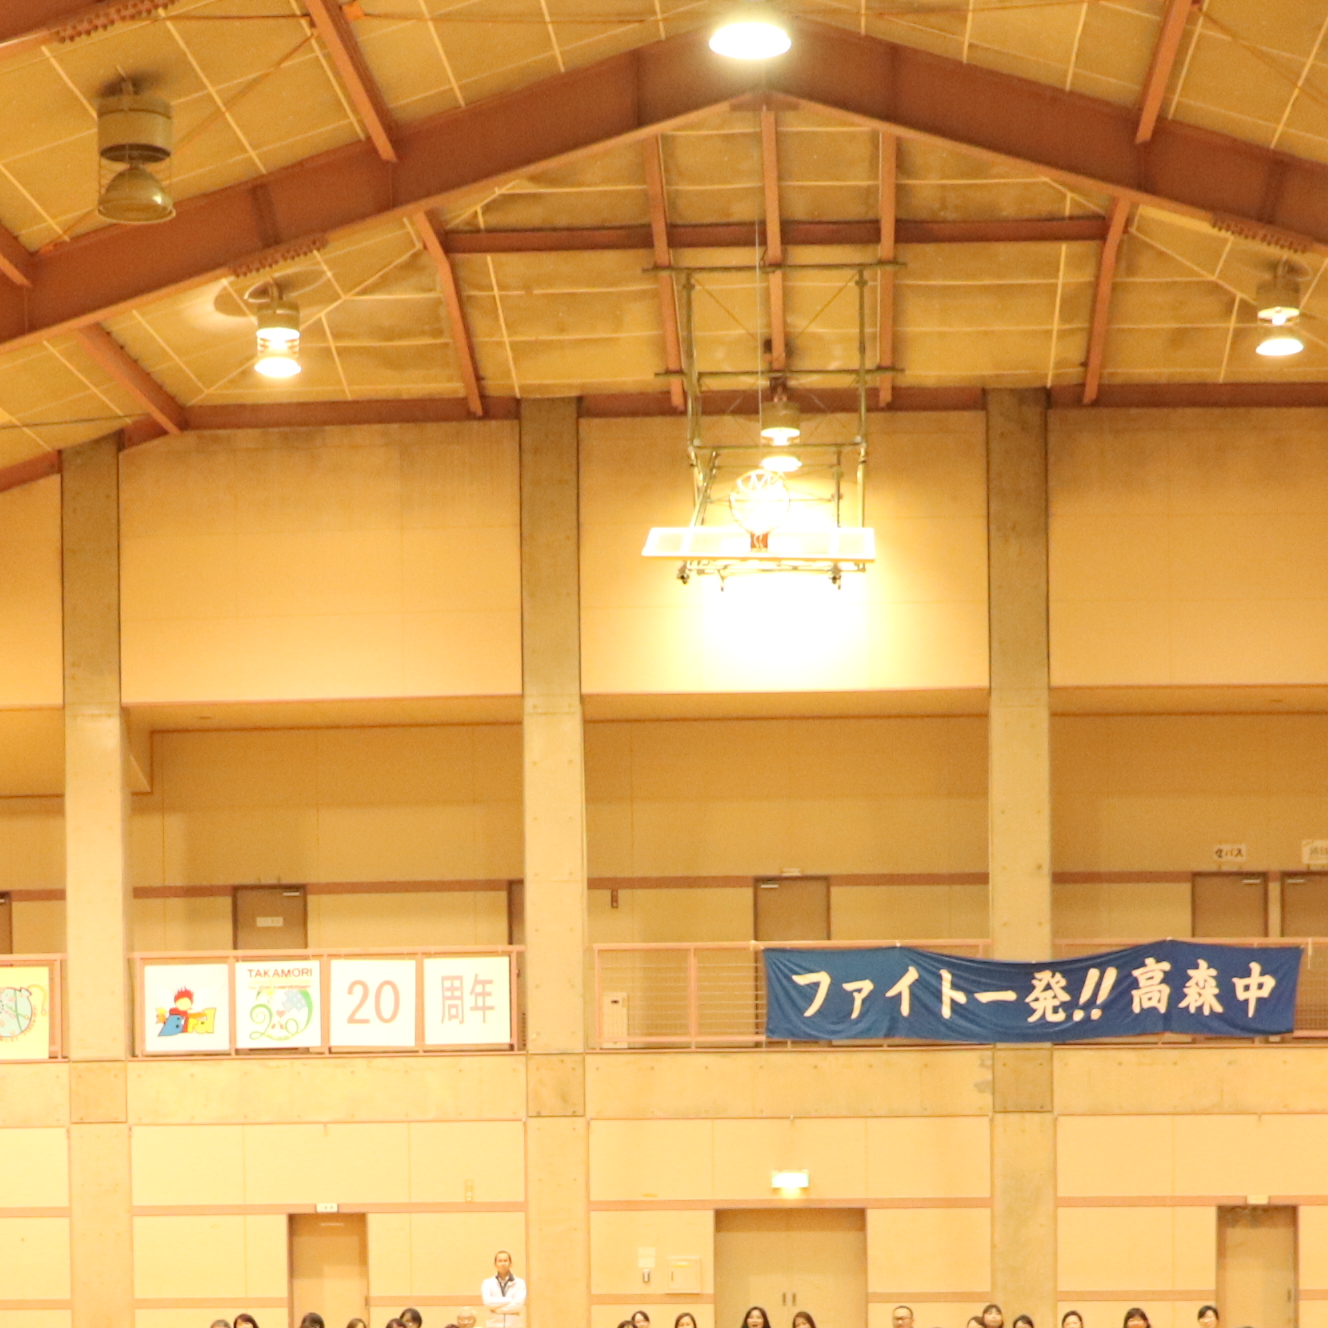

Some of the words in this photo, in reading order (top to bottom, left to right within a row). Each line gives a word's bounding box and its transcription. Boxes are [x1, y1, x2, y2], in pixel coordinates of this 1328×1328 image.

[247, 968, 312, 979] TAKAMORI
[347, 980, 400, 1024] 20
[440, 973, 495, 1024] 周年
